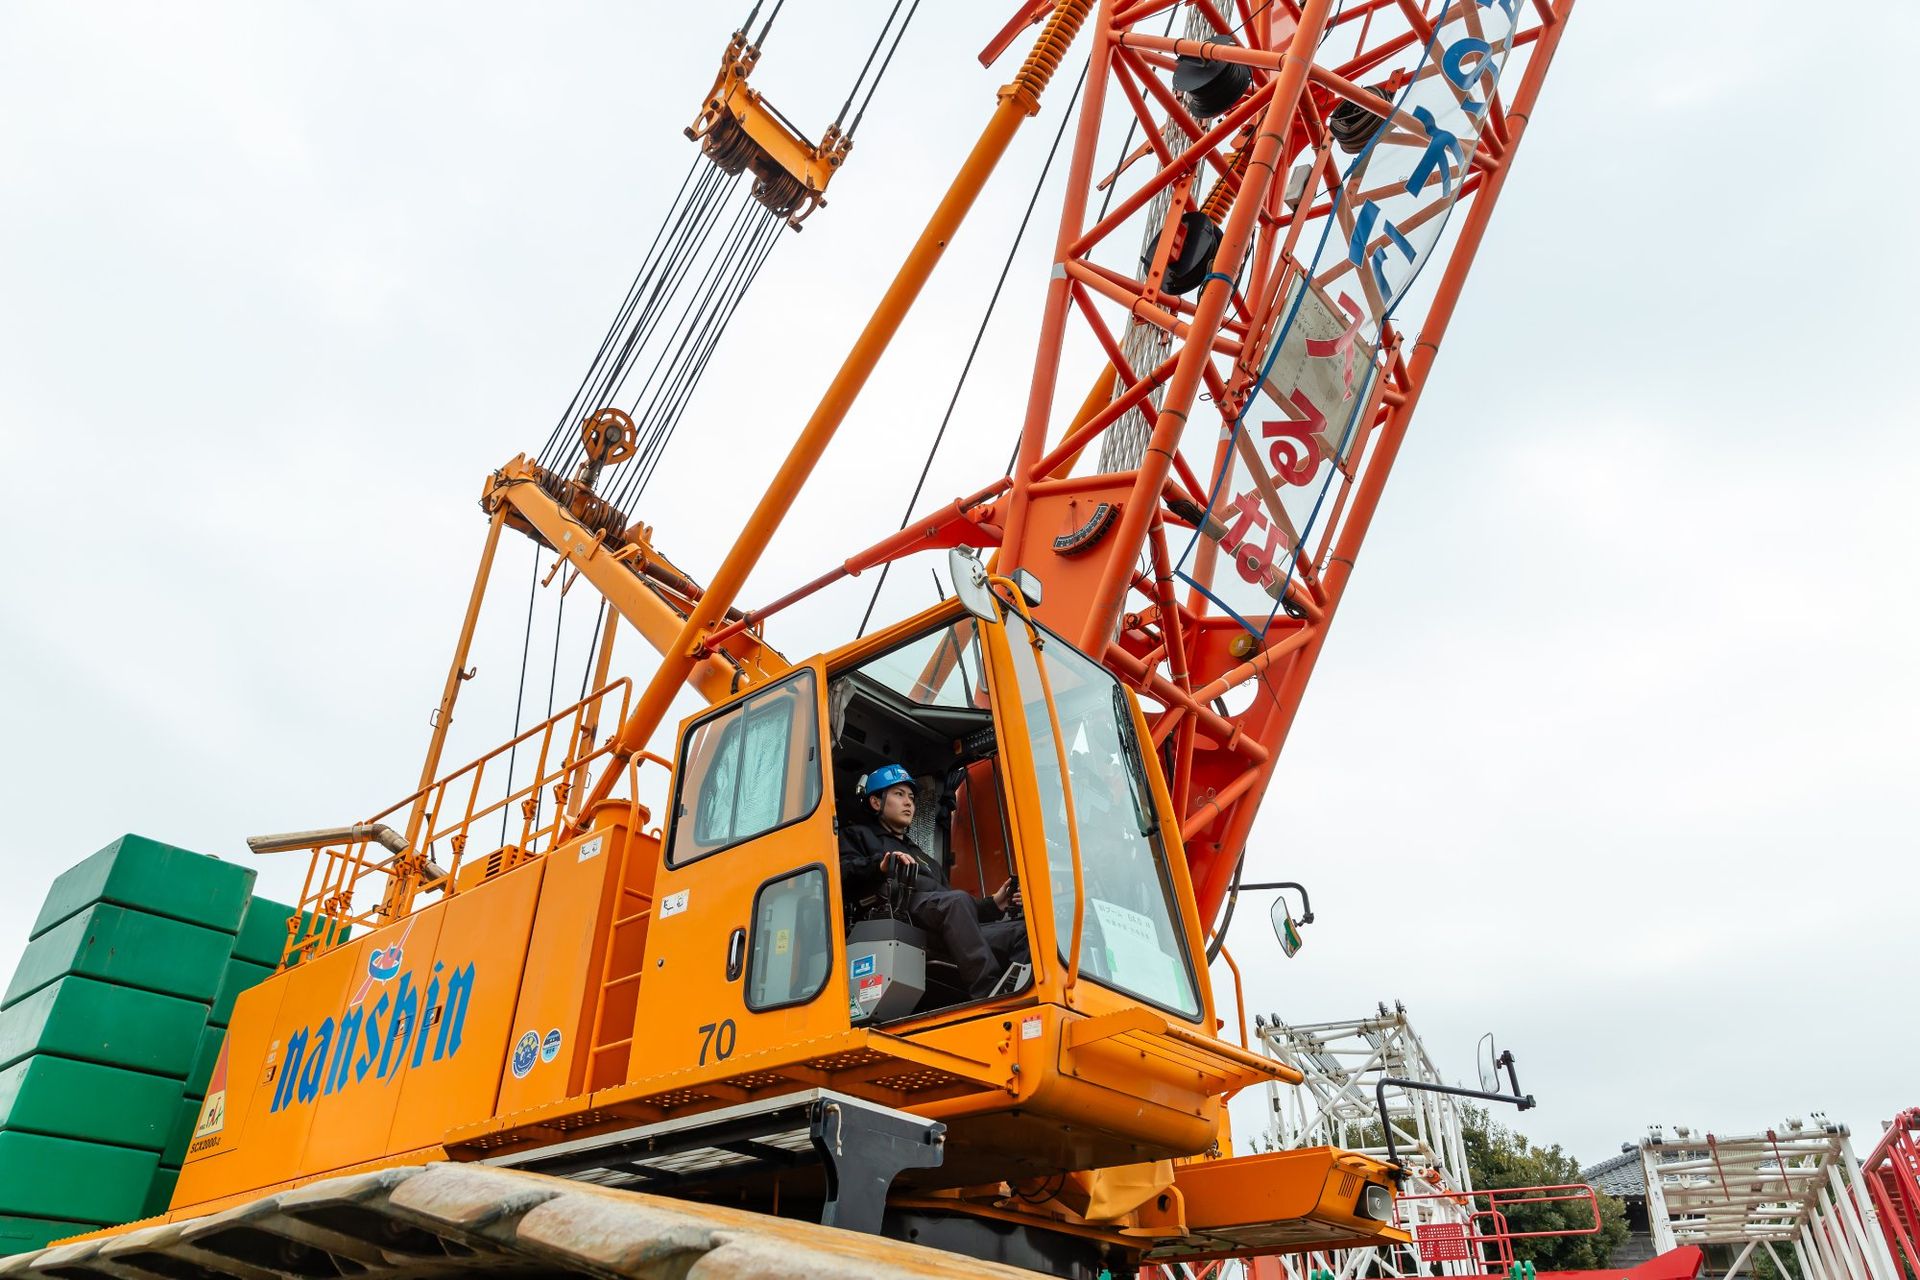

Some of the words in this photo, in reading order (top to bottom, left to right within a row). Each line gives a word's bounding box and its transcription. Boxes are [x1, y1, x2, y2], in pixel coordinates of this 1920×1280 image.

[1217, 0, 1524, 589] の下に入るな
[270, 960, 475, 1113] nanshin
[698, 1018, 736, 1066] 70
